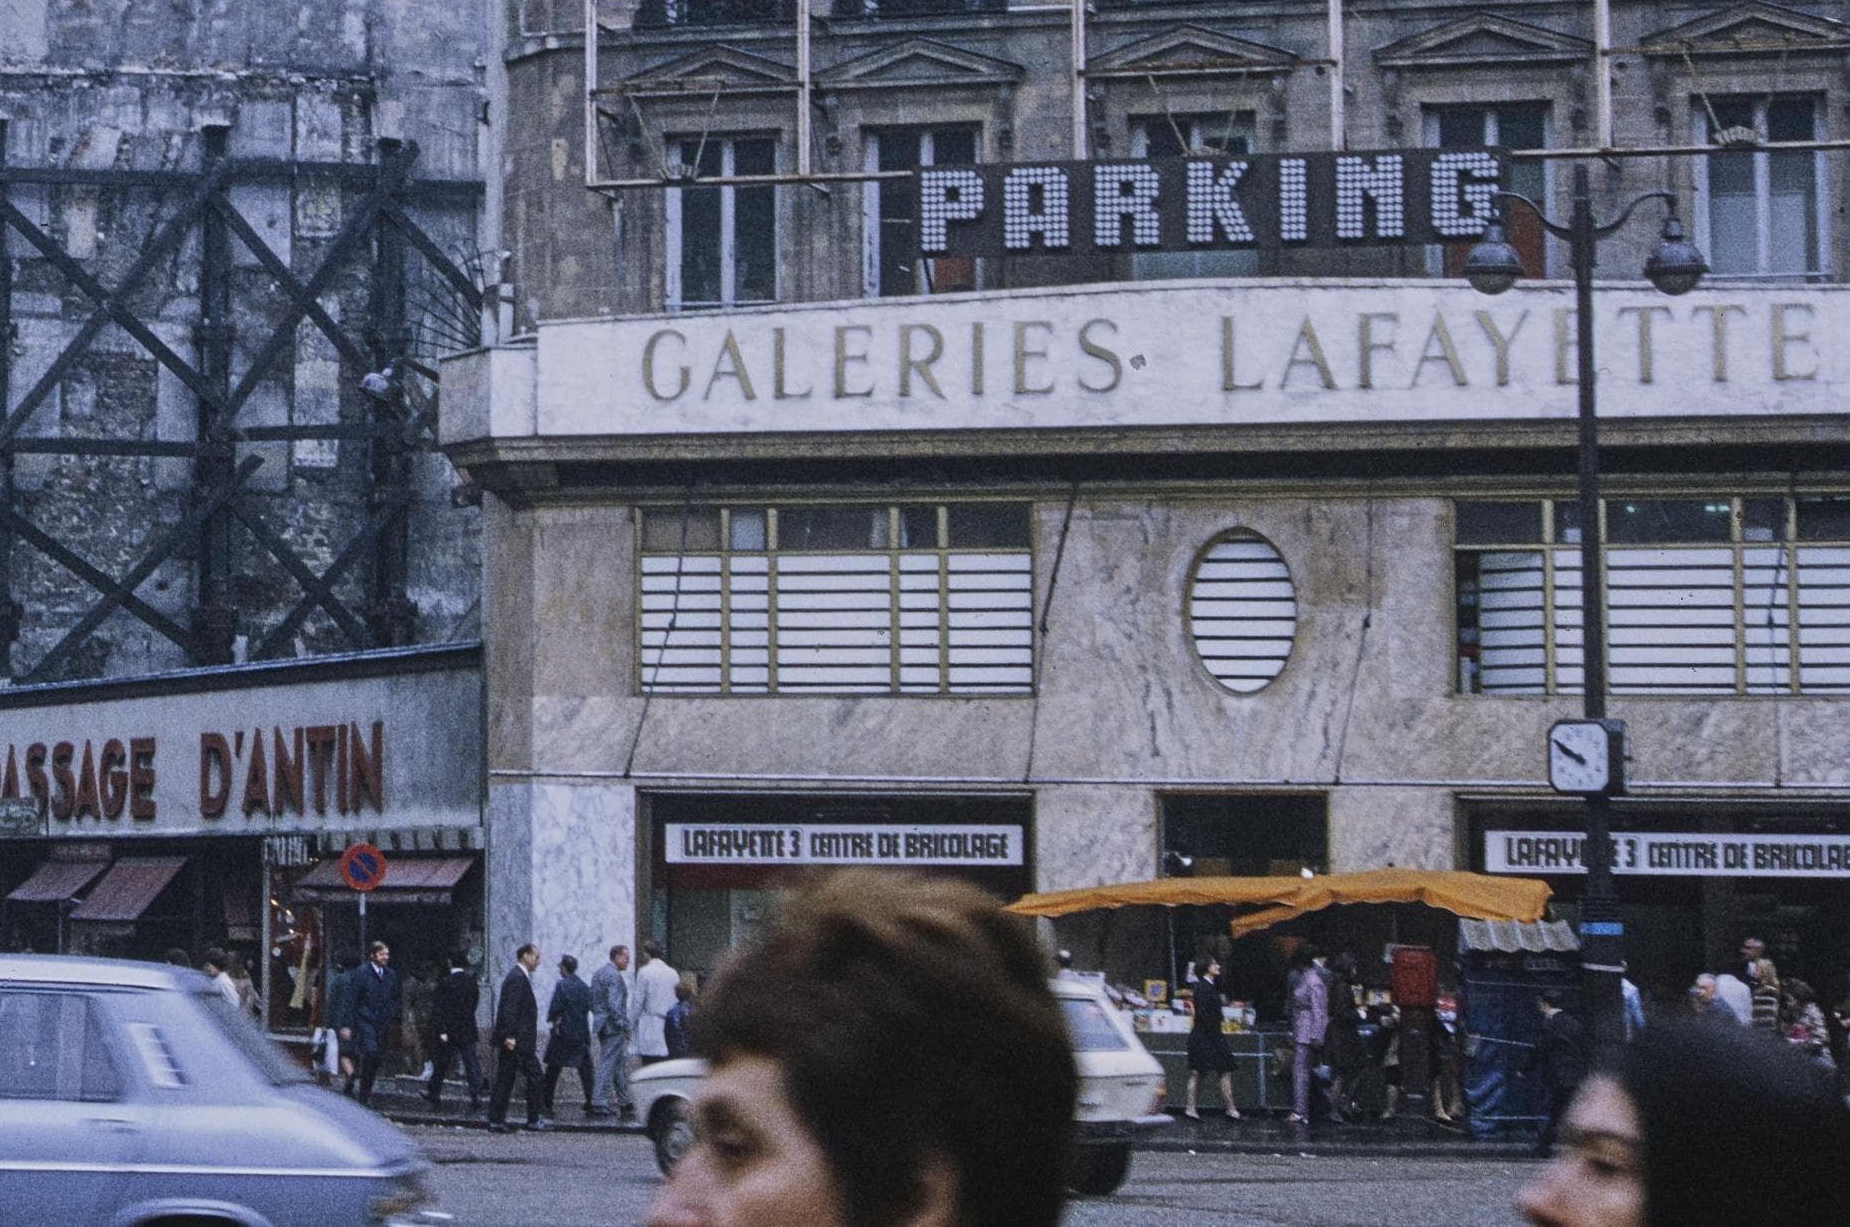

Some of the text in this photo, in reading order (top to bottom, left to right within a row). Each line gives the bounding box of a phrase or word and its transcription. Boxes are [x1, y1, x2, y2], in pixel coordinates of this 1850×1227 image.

[920, 151, 1500, 252] PARKING
[641, 302, 1819, 403] GALERIES LAFAYETTE
[199, 720, 384, 819] D'ANTIN
[683, 829, 1009, 860] LAFAYETTE 3 CENTRE DE BRICOLAGE
[1623, 838, 1637, 868] 3
[1649, 842, 1719, 869] CENTRE
[1723, 843, 1748, 870] DE
